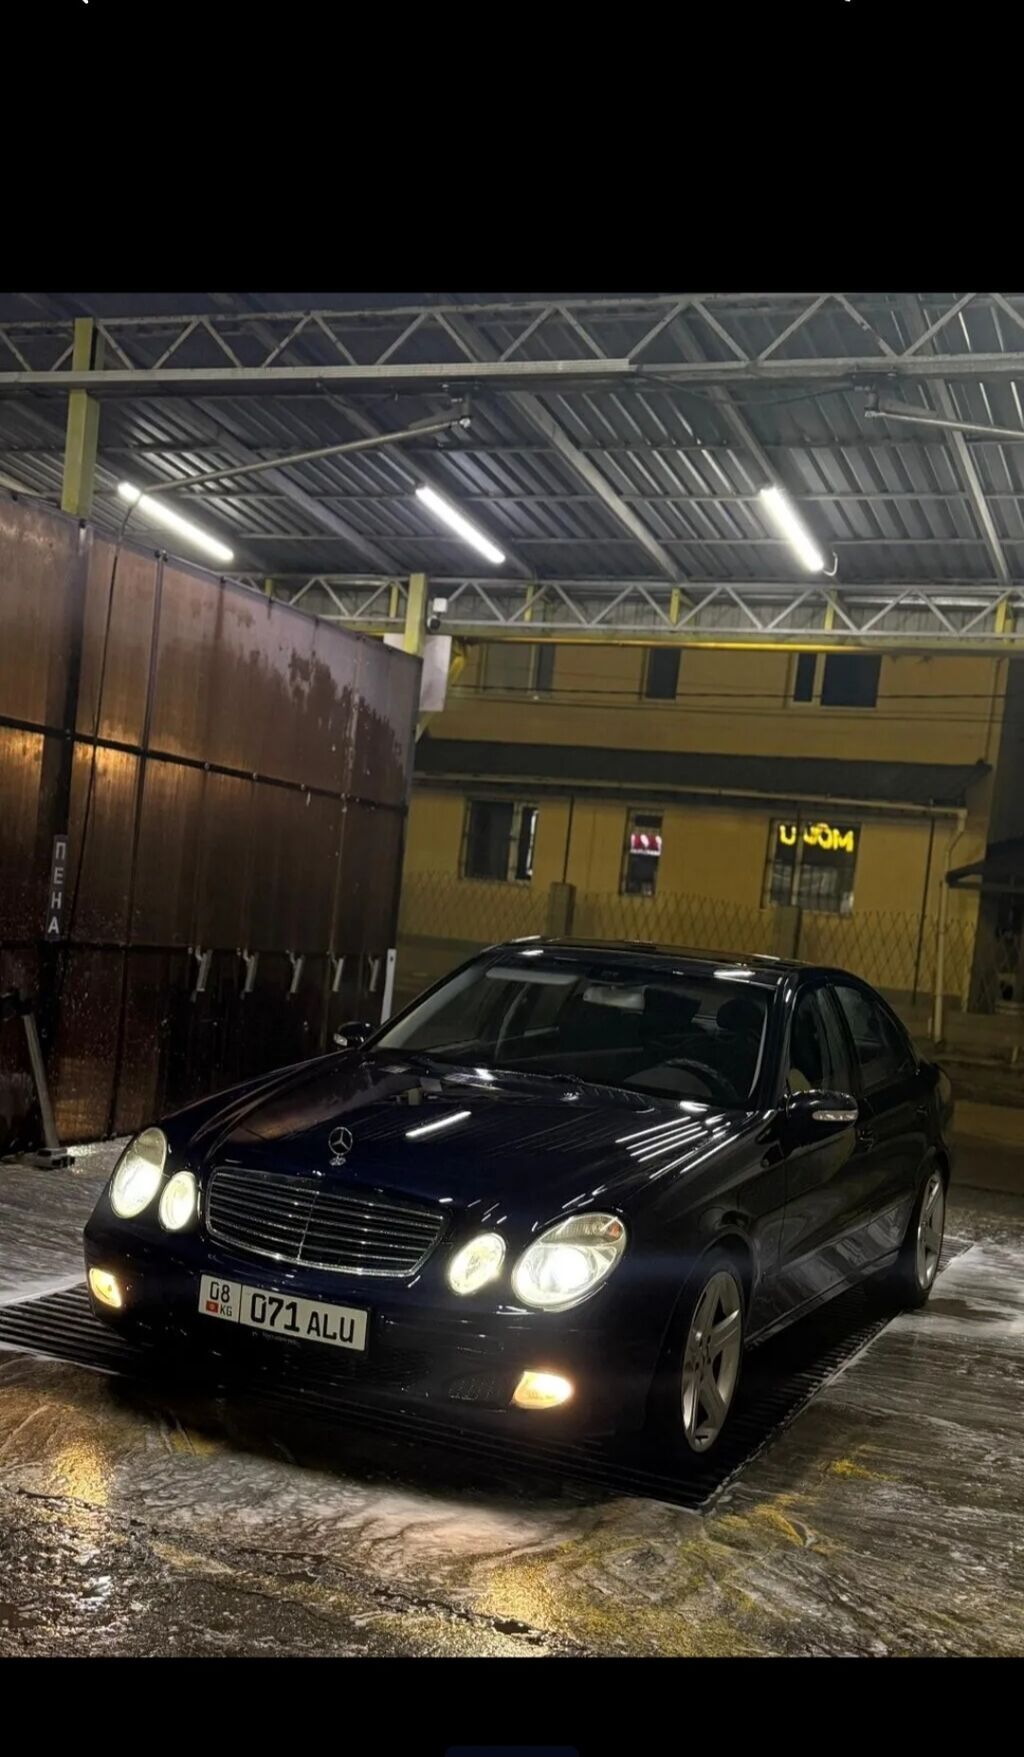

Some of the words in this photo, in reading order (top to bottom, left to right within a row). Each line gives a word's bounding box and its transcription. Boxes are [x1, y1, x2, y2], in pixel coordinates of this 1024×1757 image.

[48, 842, 66, 934] ПЕНА
[210, 1281, 230, 1303] 08
[220, 1305, 232, 1317] KG
[250, 1293, 300, 1333] 071
[306, 1311, 355, 1343] ALU
